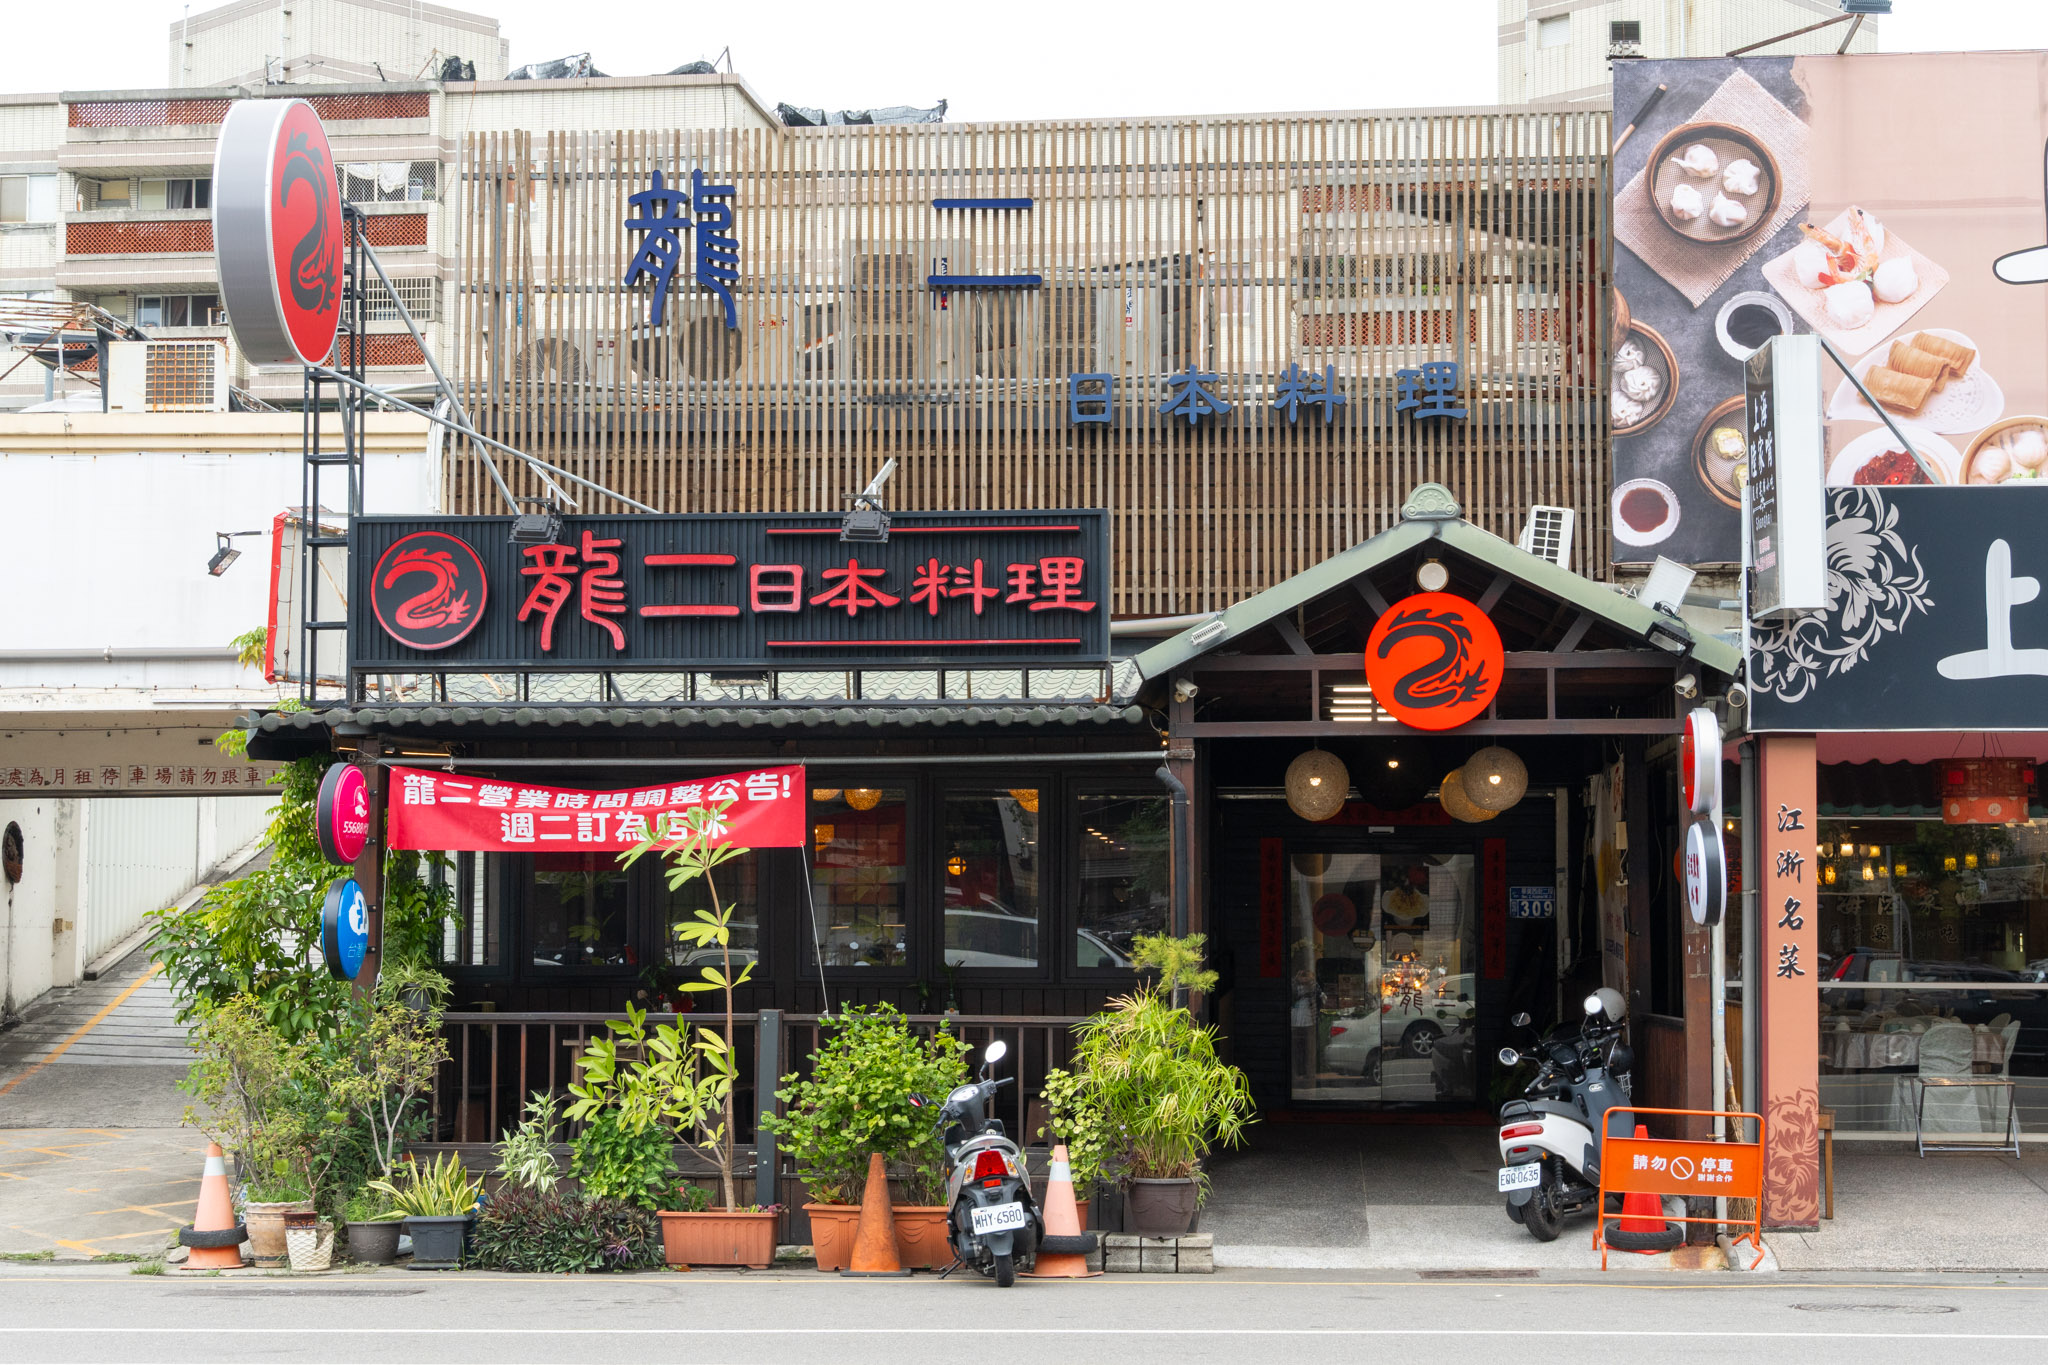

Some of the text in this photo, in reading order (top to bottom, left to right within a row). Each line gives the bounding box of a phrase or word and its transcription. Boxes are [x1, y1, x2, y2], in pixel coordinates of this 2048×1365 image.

[623, 168, 1043, 329] 龍二
[1069, 361, 1468, 425] 日本料理
[1936, 538, 2048, 680] 上
[402, 772, 792, 810] 龍二營業時間調整公告!
[1520, 900, 1553, 917] 309
[1776, 803, 1806, 980] 江浙名菜
[1400, 983, 1457, 1016] 龍二
[1632, 1154, 1734, 1173] 請勿 停車
[1697, 1173, 1733, 1183] 謝謝合作
[974, 1208, 1022, 1229] MHY-6580
